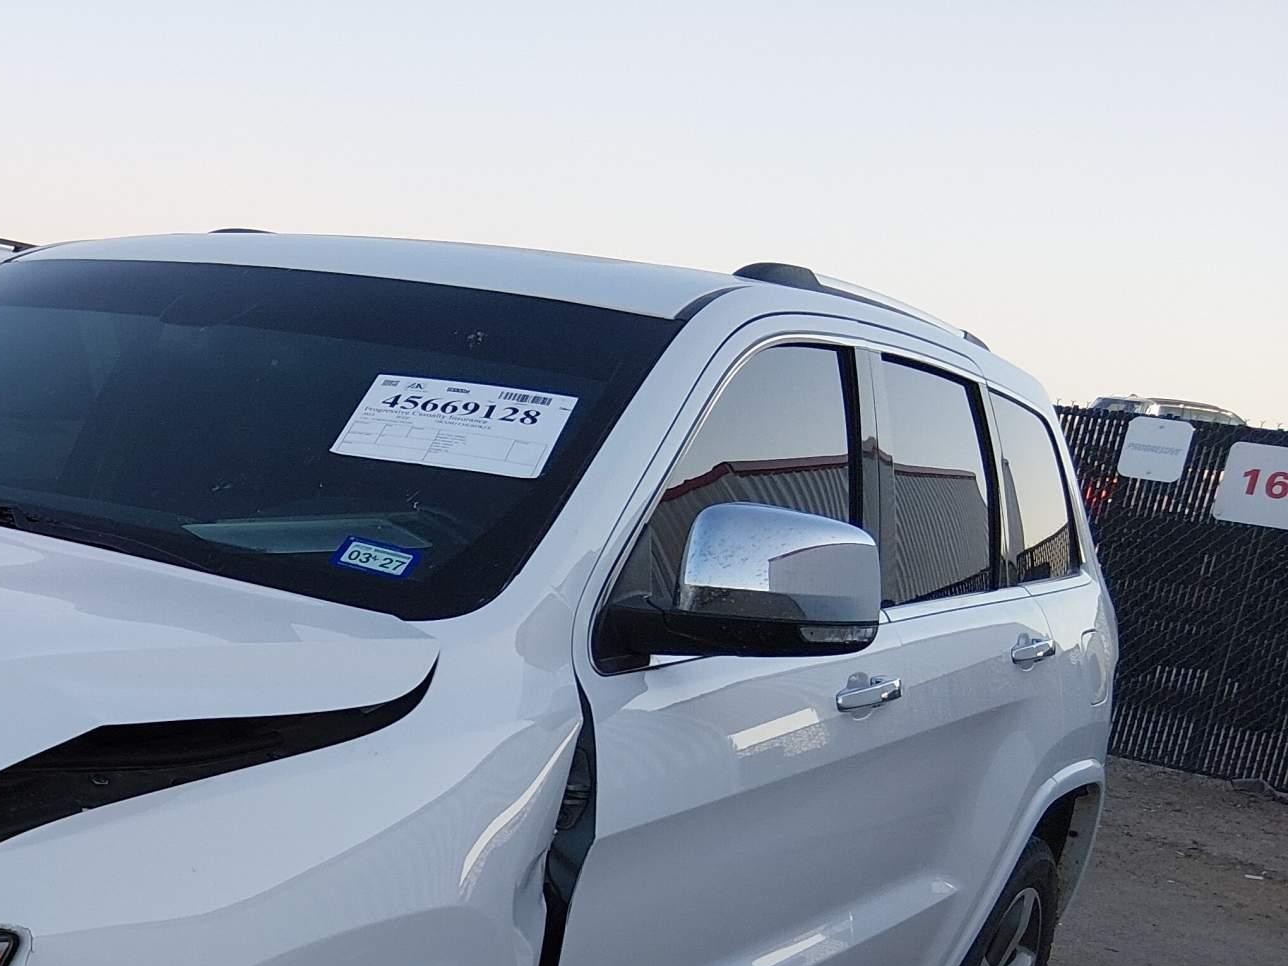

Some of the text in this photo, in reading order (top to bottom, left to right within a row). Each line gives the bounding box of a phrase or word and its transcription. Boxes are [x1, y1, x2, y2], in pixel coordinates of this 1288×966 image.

[381, 393, 542, 426] 45669128
[1243, 468, 1288, 499] 16
[348, 549, 407, 571] 03 27
